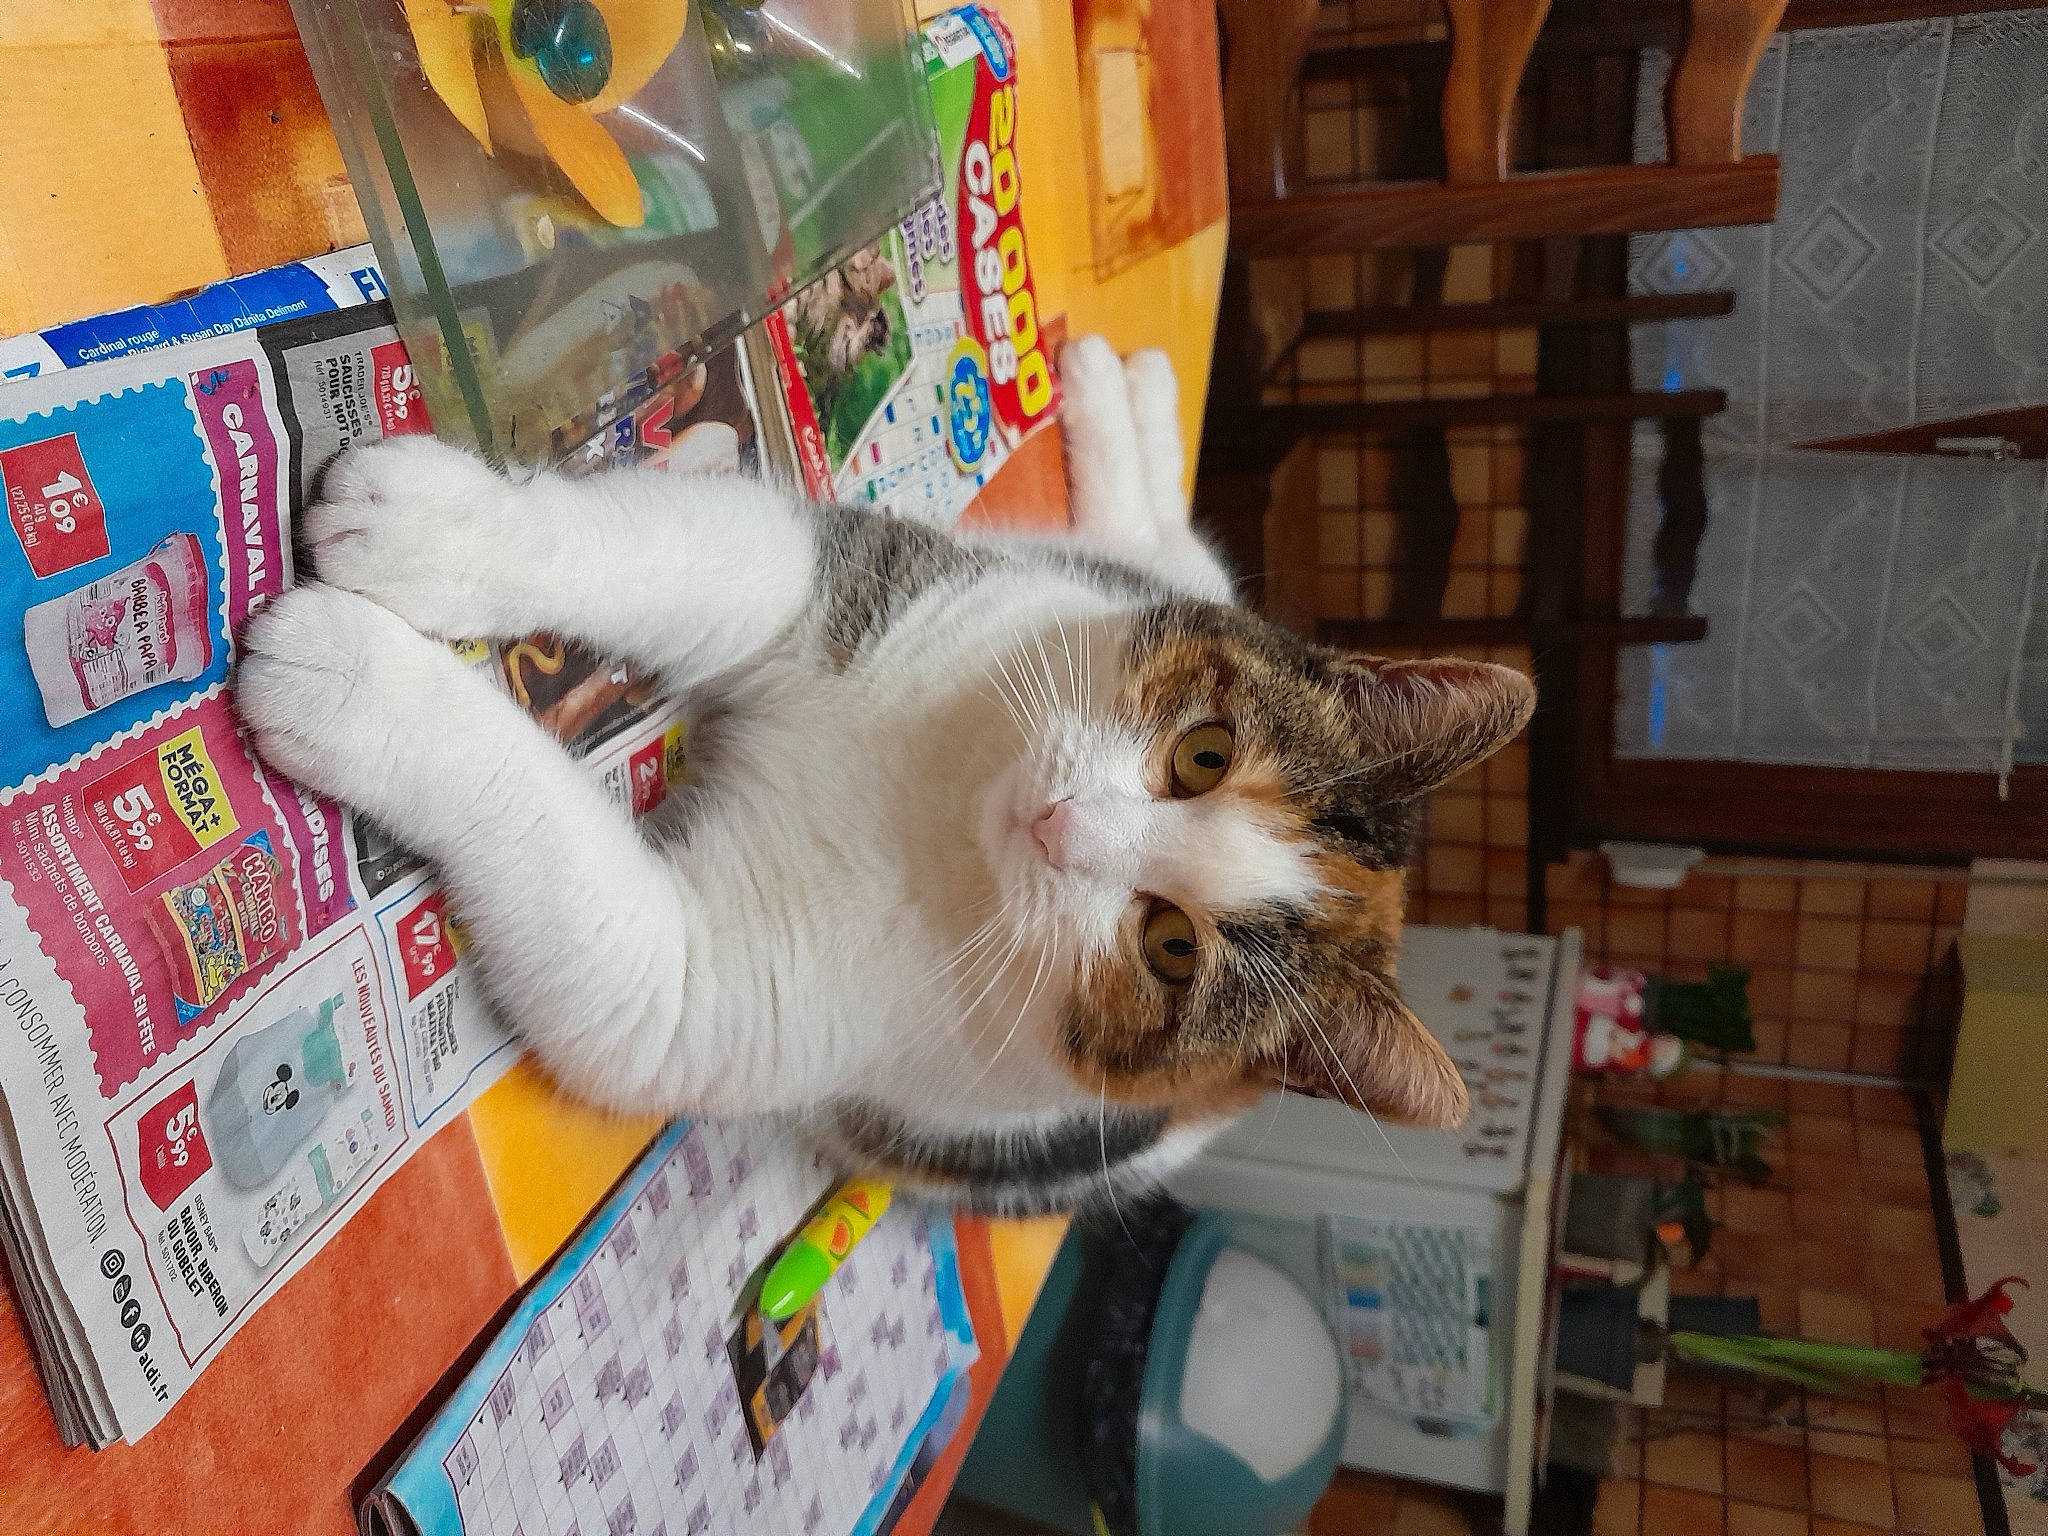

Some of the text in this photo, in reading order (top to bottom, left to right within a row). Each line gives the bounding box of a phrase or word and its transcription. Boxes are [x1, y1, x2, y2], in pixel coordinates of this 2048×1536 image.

[965, 140, 1018, 384] CASES
[78, 336, 127, 360] Cardinal
[127, 329, 160, 349] rouge
[181, 328, 214, 343] Susan
[213, 322, 235, 338] Day
[266, 299, 308, 319] Delimont
[998, 226, 1054, 417] 000
[326, 357, 340, 400] POUR
[340, 354, 363, 438] SAUCISSES
[354, 350, 365, 392] TRADER
[332, 402, 349, 434] HOT
[222, 403, 266, 591] CARNAVAL
[131, 579, 148, 622] BARBE
[137, 635, 158, 671] PAPA
[162, 751, 209, 834] FORMAT
[15, 840, 43, 882] 5011533
[25, 810, 110, 970] Mini sachets de bonbons.
[242, 852, 277, 943] HARIBO
[41, 803, 157, 1056] ASSORTIMENT CARNAVAL EN FÊTE
[351, 956, 396, 1132] LES NOUVEAUTÉS DU SAMEDI
[0, 978, 108, 1250] CONSOMMER AVEC MODÉRATION.
[194, 1193, 211, 1229] DISNEY
[161, 1245, 178, 1282] 5011702
[167, 1217, 205, 1299] OU GOBELET
[180, 1205, 229, 1317] BAVOIR, BIBERON
[138, 1353, 170, 1403] aldi.fr
